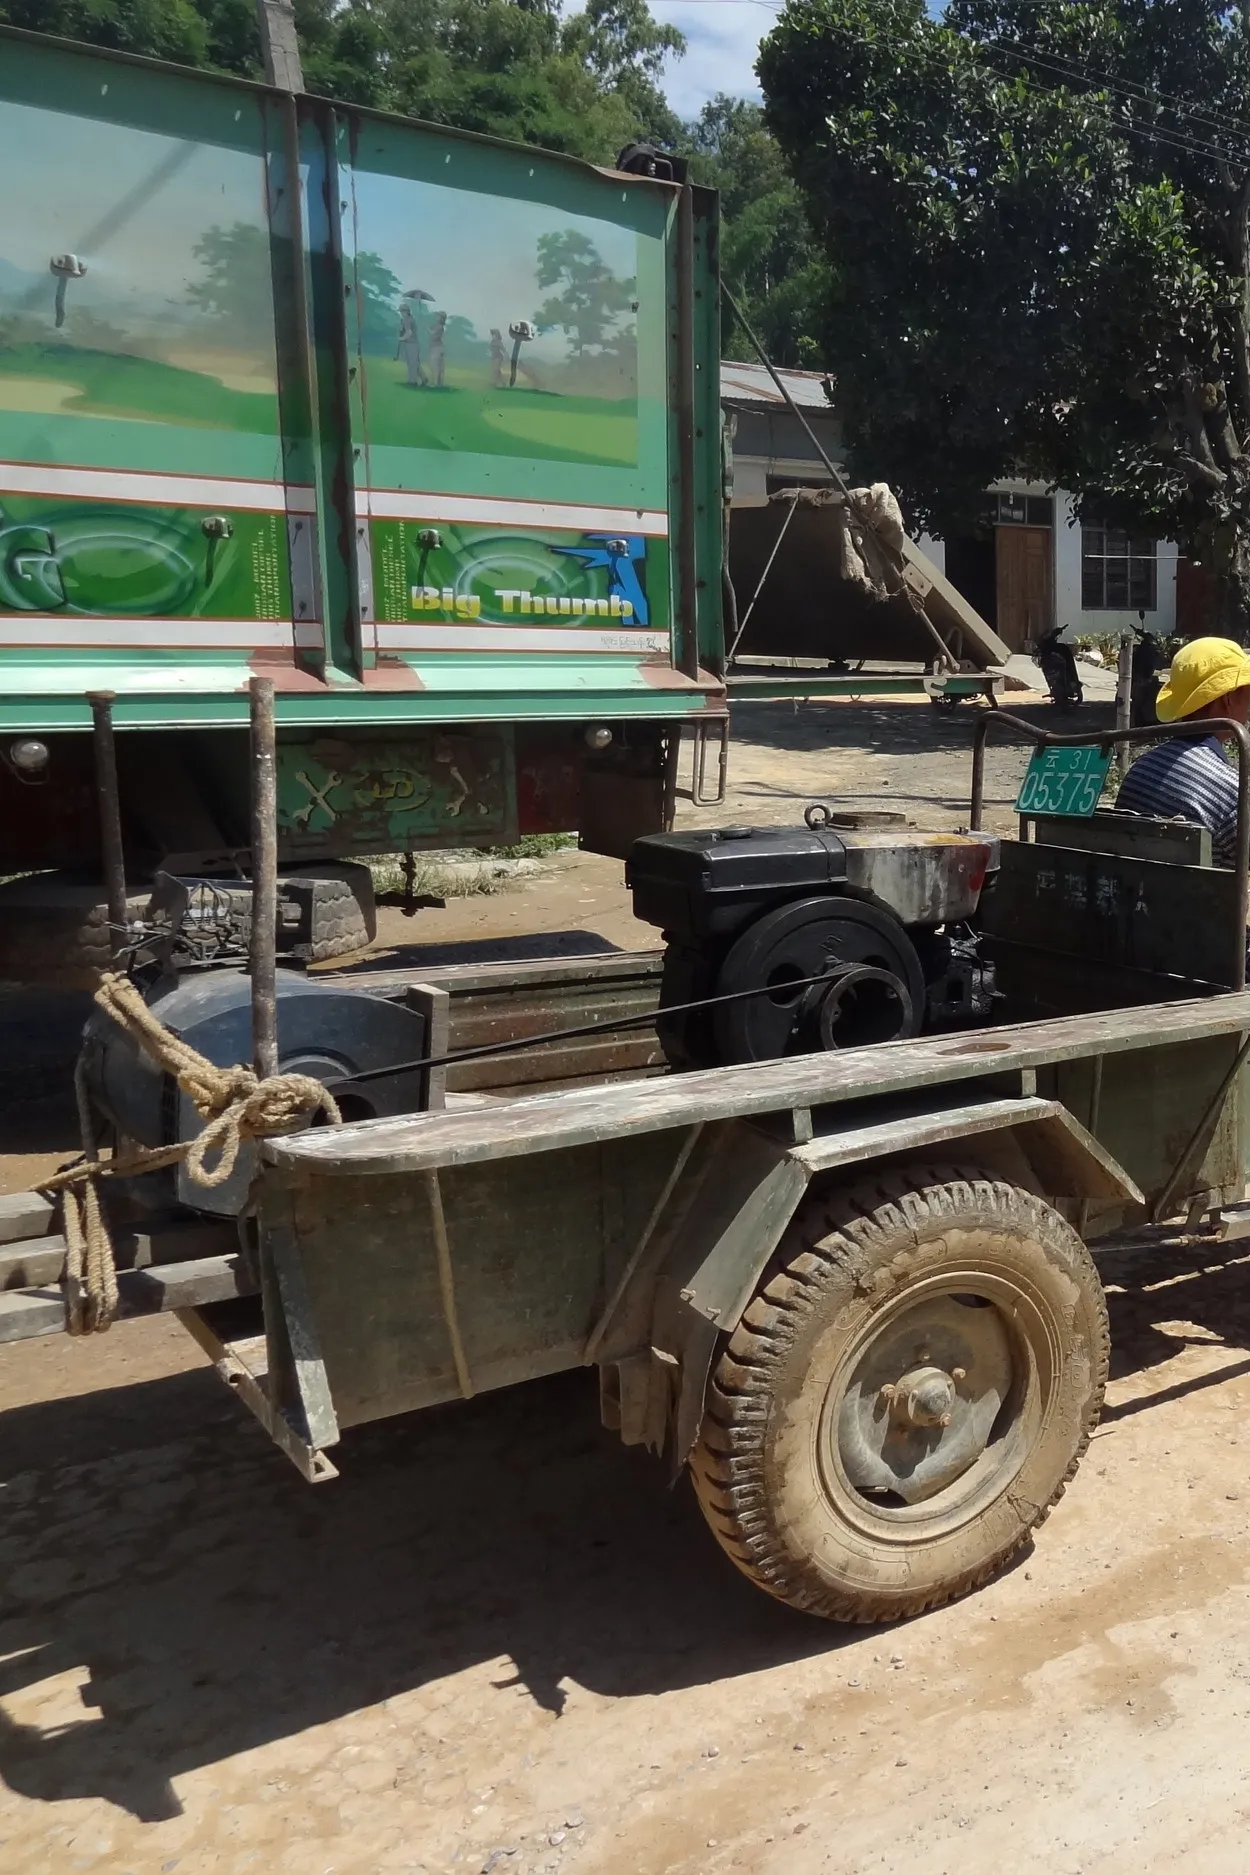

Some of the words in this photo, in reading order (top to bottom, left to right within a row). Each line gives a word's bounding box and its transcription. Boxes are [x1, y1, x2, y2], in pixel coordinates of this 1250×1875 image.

[411, 585, 481, 619] Big
[494, 588, 634, 618] Thumb
[1046, 749, 1060, 769] 云
[1070, 749, 1092, 770] 31
[1020, 771, 1101, 813] 05375
